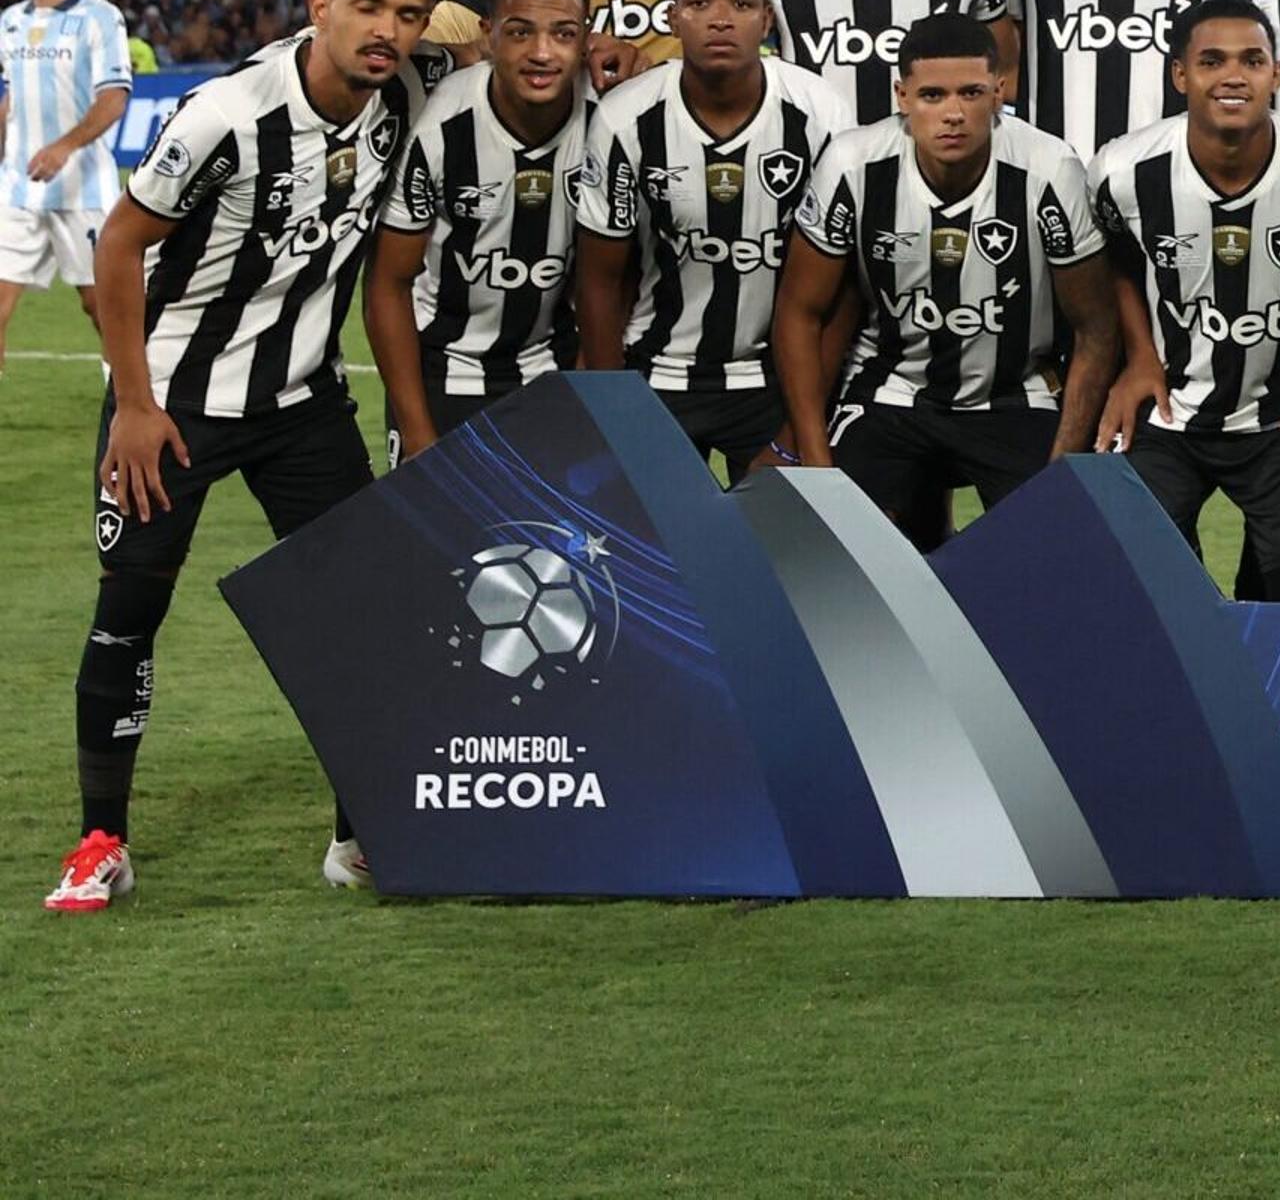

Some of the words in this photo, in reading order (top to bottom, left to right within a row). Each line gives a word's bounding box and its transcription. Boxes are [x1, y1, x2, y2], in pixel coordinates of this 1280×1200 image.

[800, 19, 902, 67] vbe
[1047, 7, 1175, 54] vbet
[880, 287, 1005, 336] vbet
[415, 772, 607, 810] RECOPA
